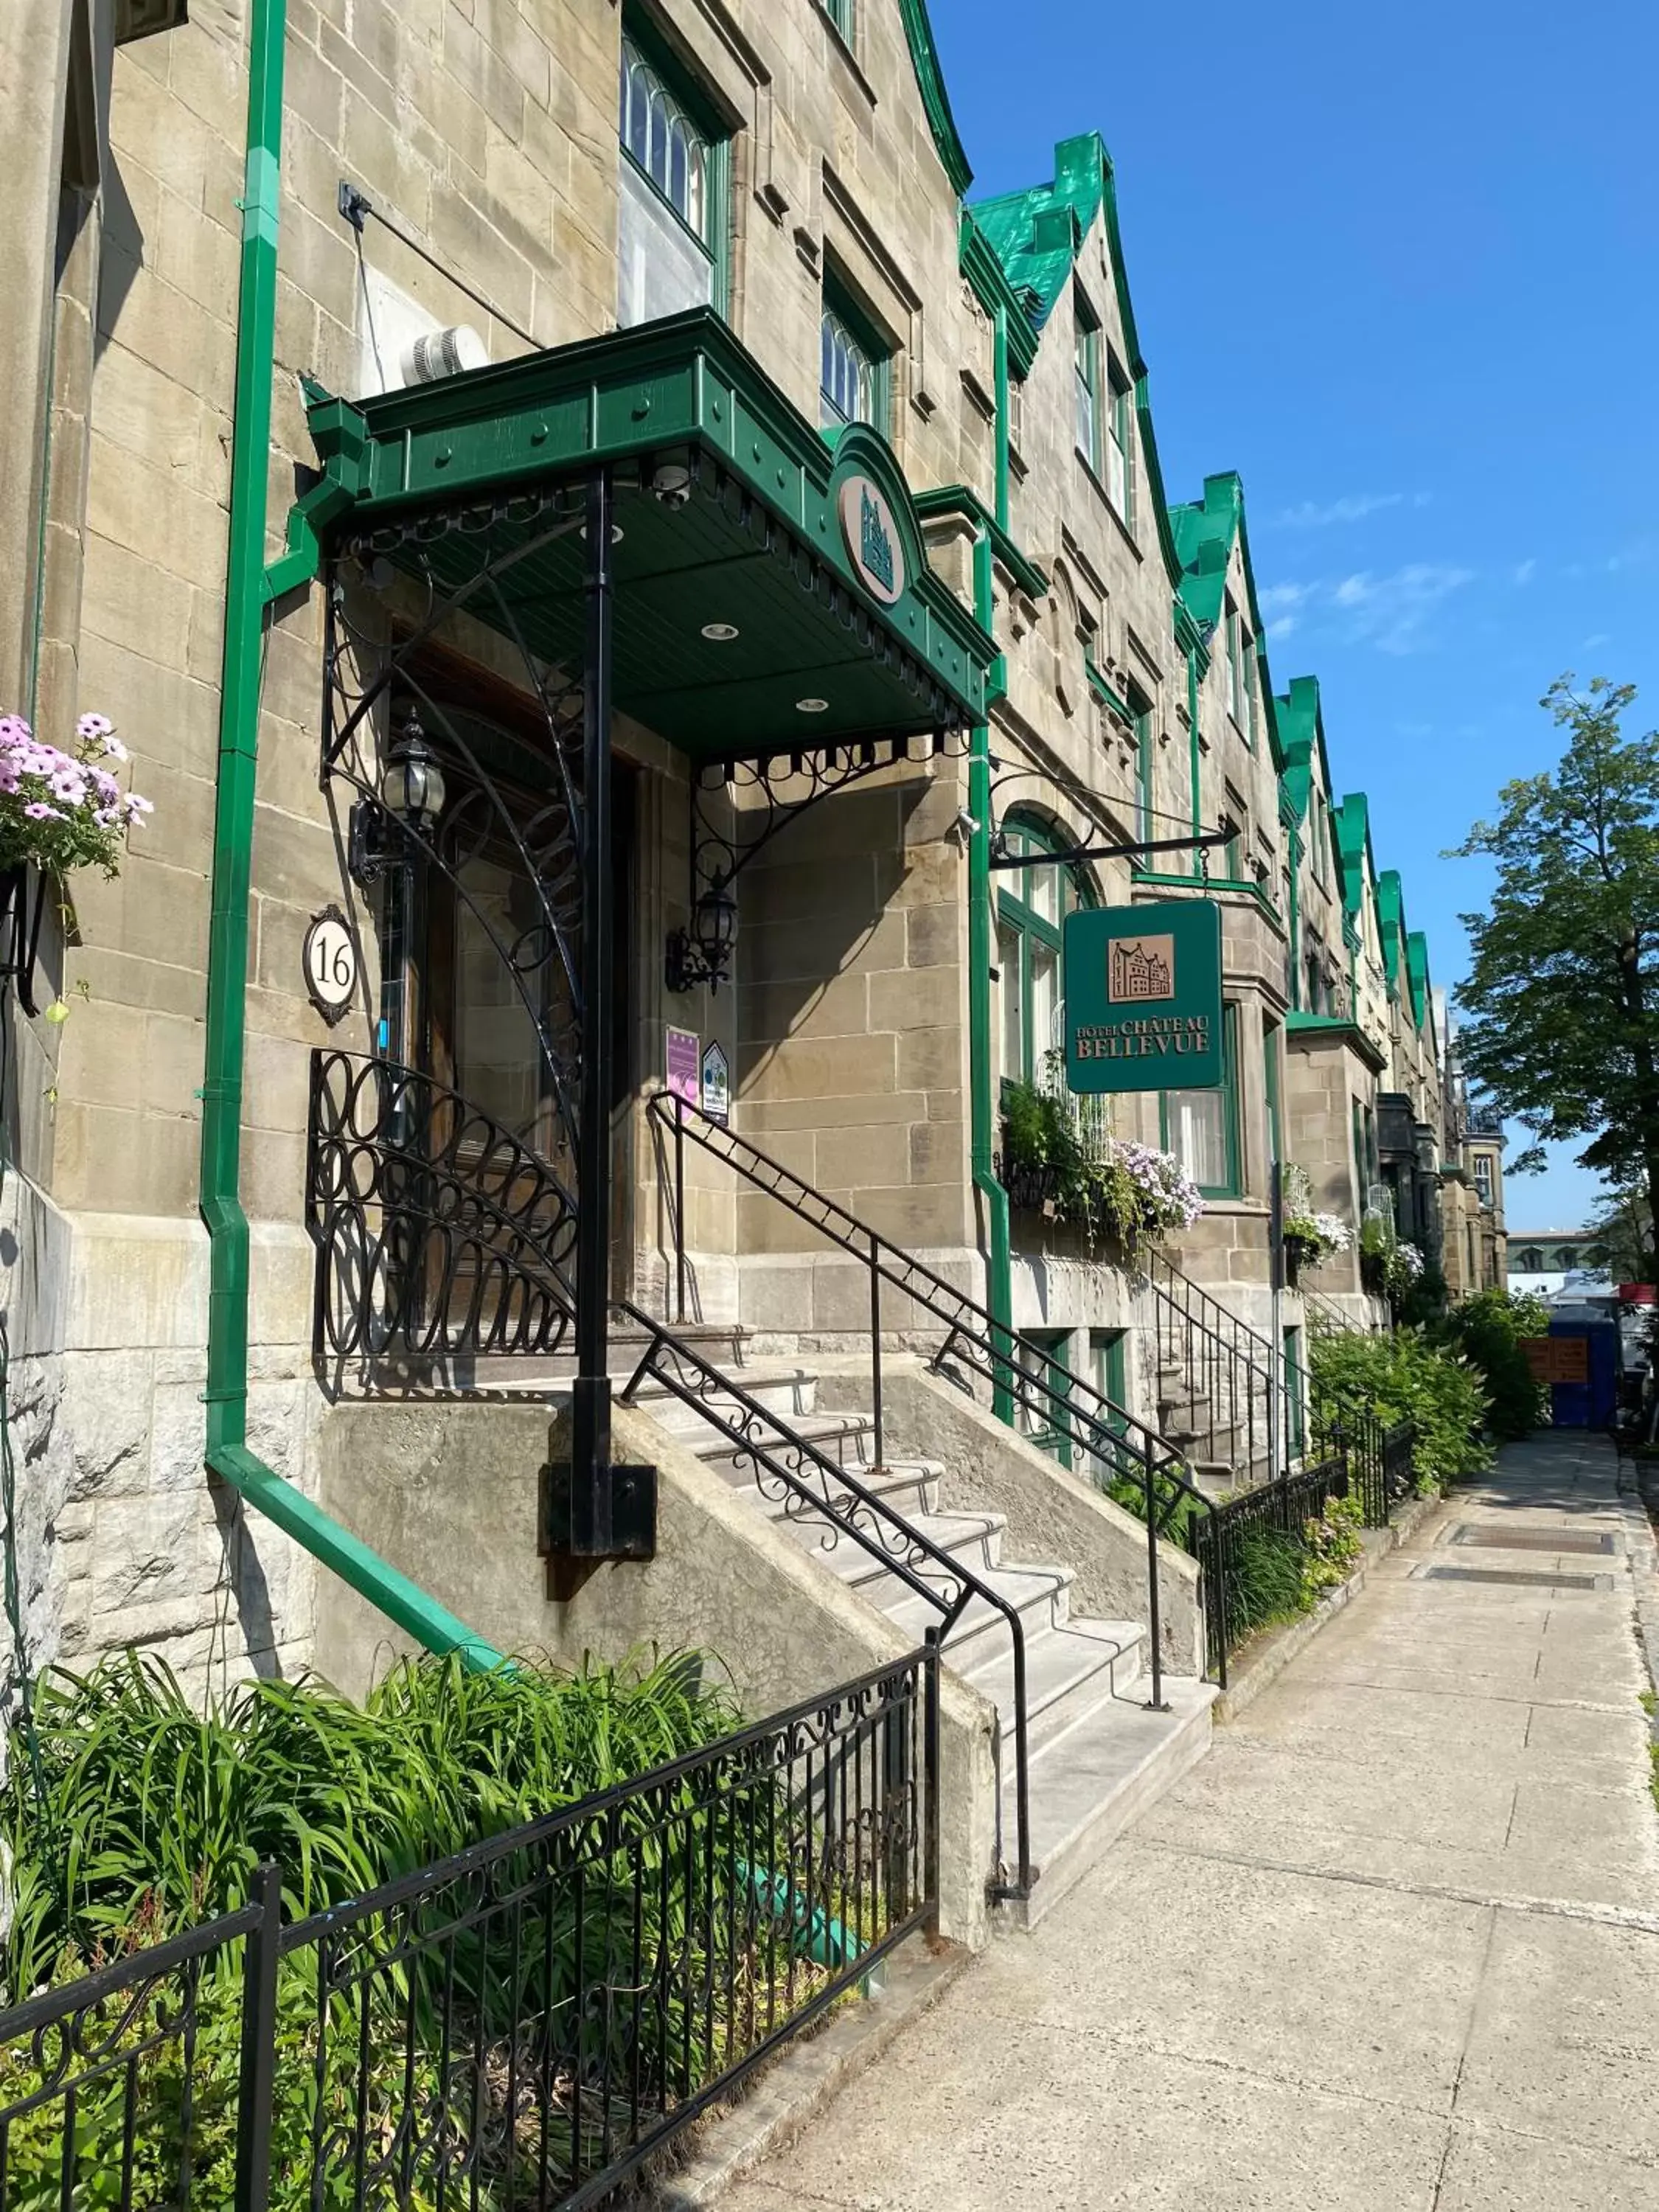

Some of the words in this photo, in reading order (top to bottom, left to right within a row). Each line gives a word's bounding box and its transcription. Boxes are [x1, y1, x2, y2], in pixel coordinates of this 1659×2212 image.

[316, 936, 350, 987] 16
[1077, 1024, 1119, 1038] HÔTEL
[1120, 1015, 1209, 1035] CHÂTEAU
[1077, 1032, 1210, 1060] BELLEVUE
